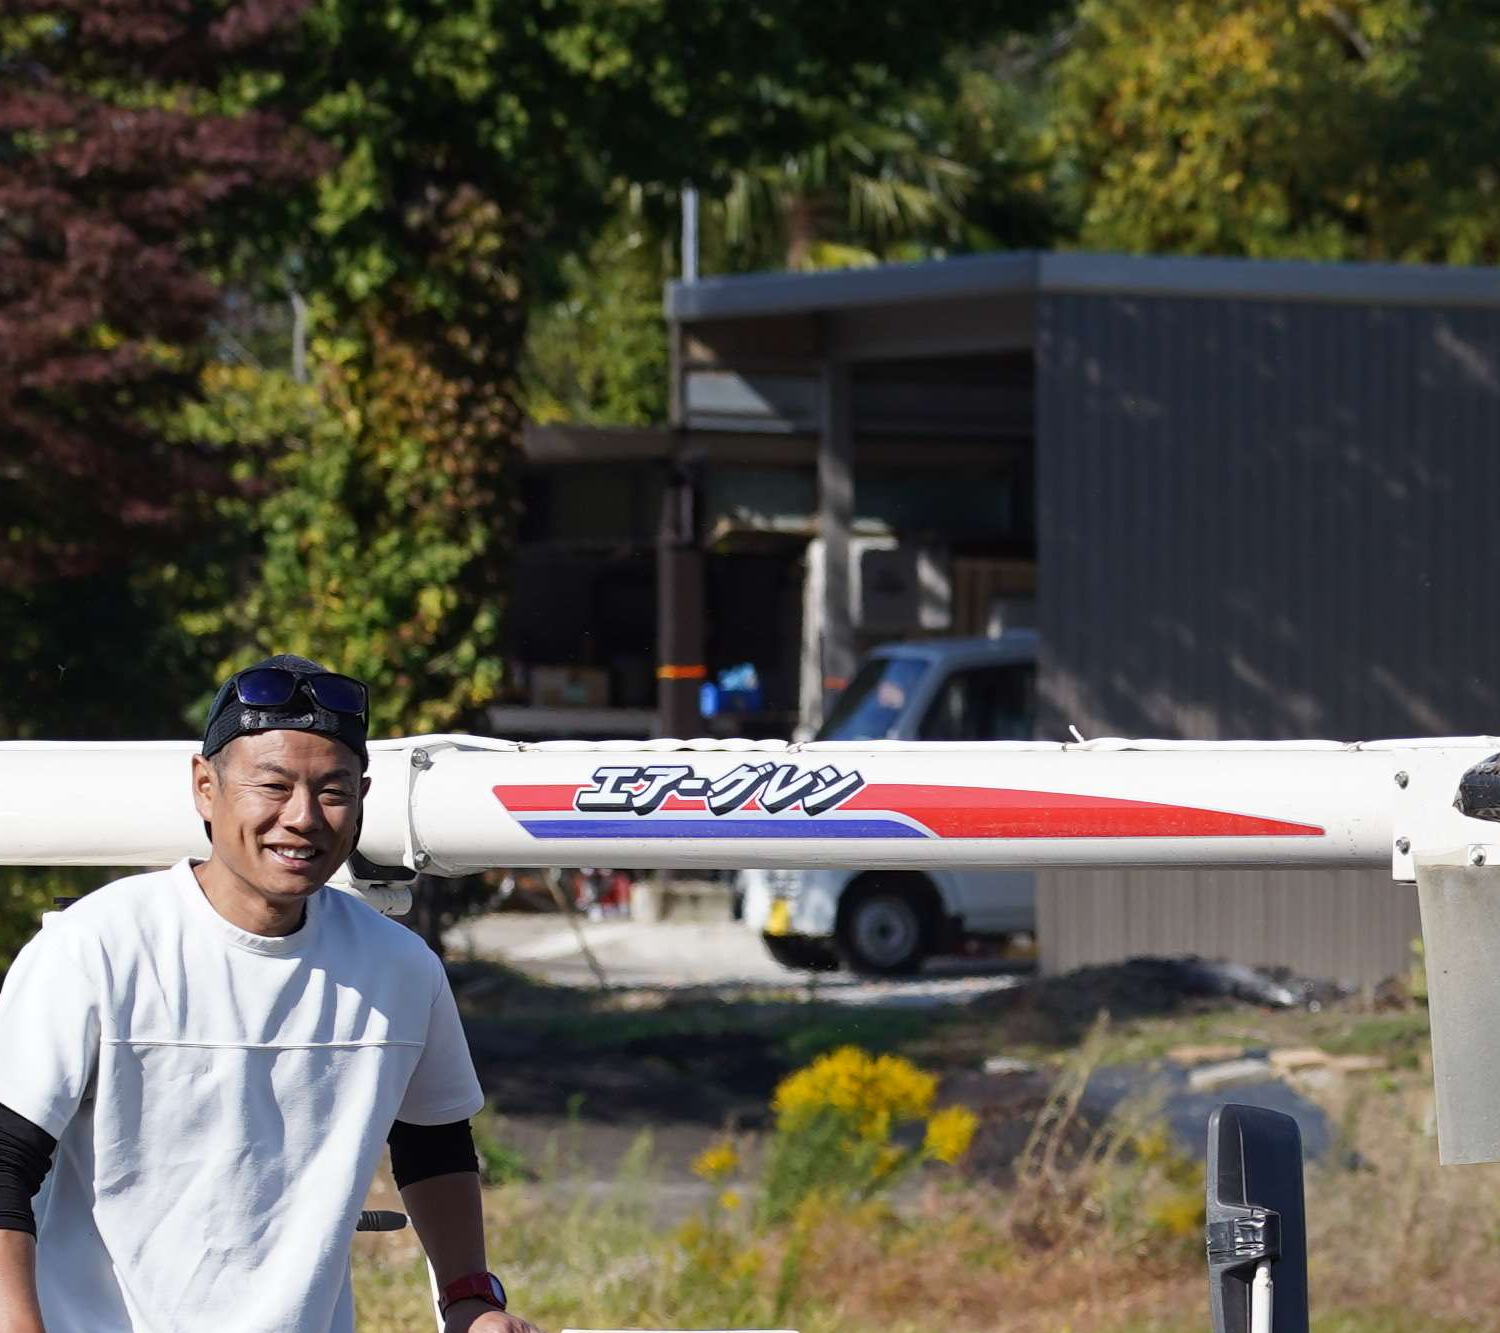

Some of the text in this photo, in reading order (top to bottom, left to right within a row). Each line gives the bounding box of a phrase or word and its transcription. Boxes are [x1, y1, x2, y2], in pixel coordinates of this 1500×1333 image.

[576, 762, 864, 816] エアーグレン
